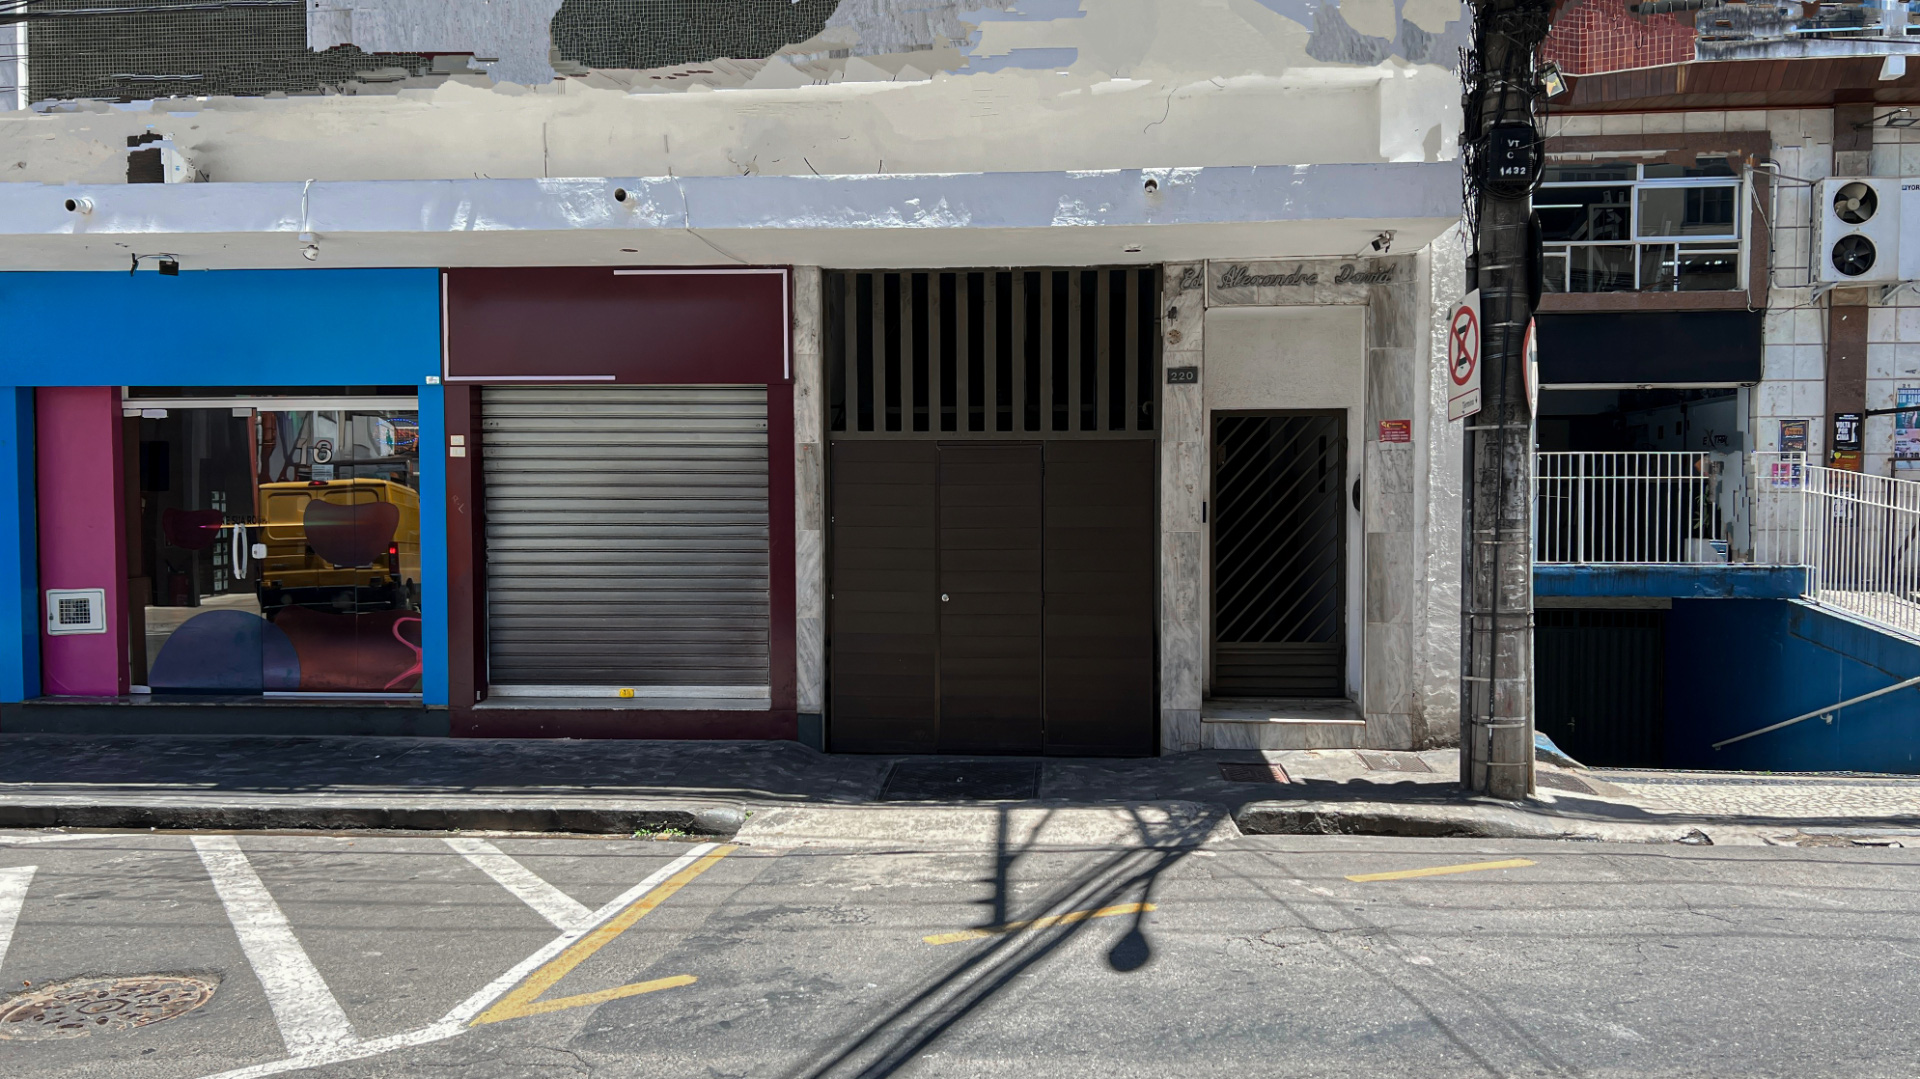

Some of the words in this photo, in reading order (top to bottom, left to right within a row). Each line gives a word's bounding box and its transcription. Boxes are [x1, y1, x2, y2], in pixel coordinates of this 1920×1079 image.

[1507, 139, 1520, 147] VT
[1507, 151, 1514, 159] C
[1500, 166, 1526, 176] 1432
[1217, 264, 1319, 290] Alexandre
[1335, 263, 1395, 285] David
[1171, 371, 1194, 381] 220
